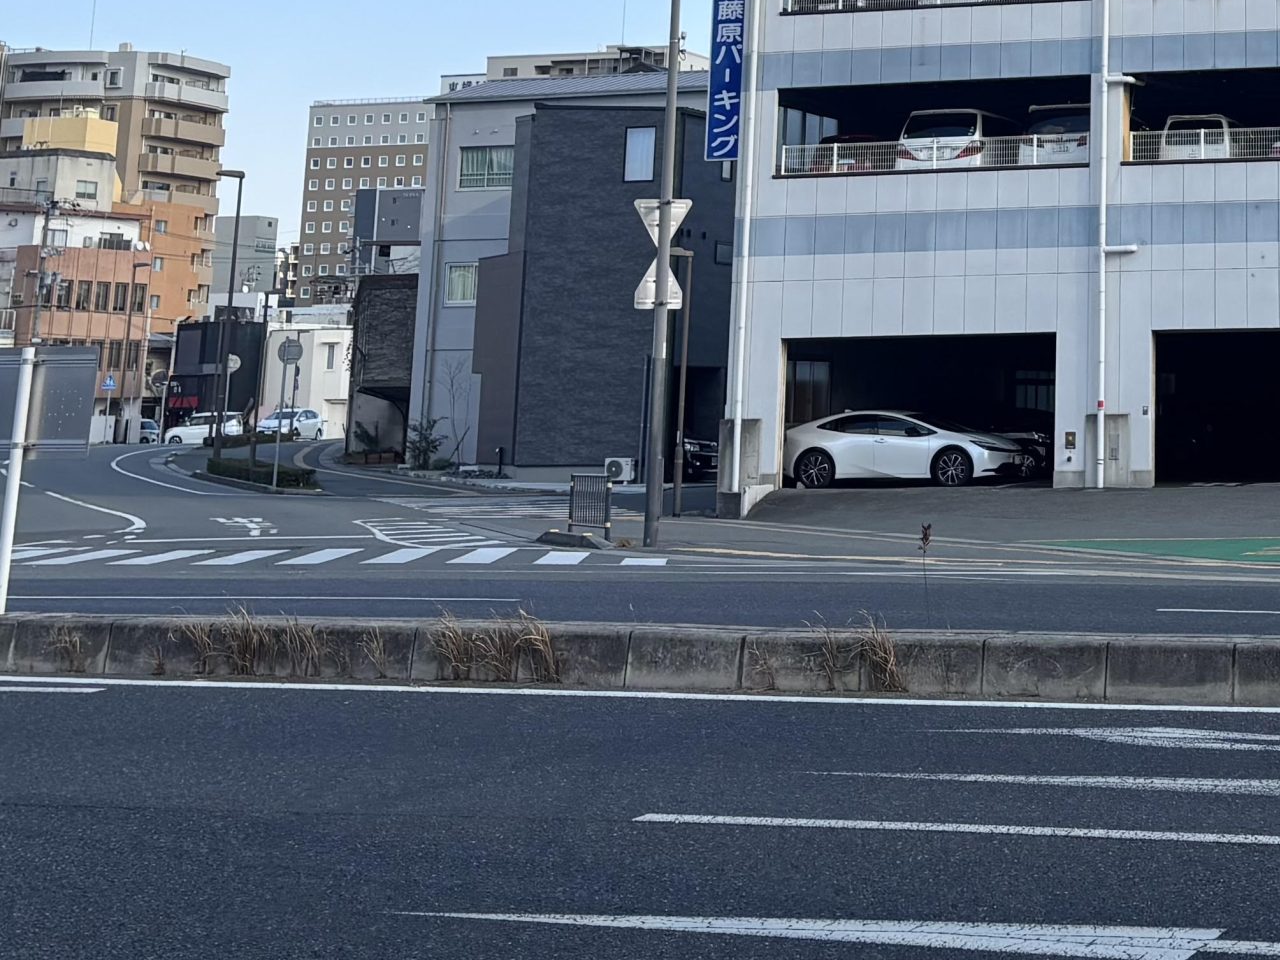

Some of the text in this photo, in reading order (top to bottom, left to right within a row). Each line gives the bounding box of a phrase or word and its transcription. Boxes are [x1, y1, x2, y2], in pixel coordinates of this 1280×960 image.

[710, 0, 745, 157] 藤原パーキング
